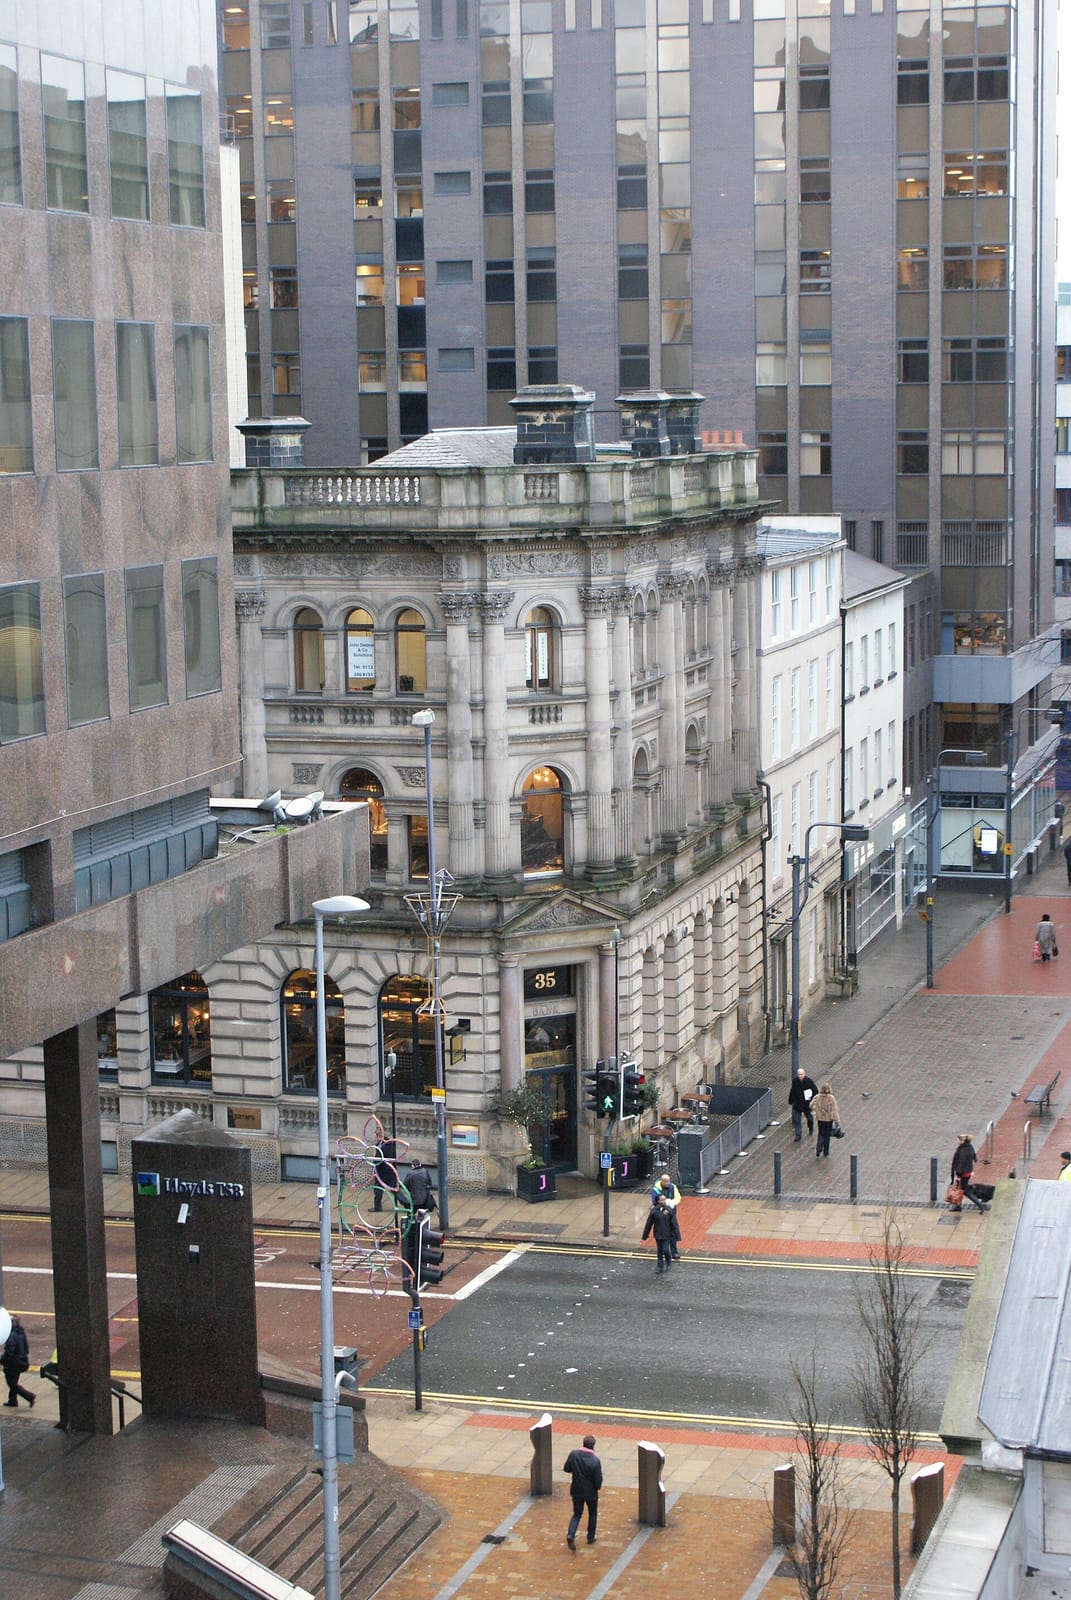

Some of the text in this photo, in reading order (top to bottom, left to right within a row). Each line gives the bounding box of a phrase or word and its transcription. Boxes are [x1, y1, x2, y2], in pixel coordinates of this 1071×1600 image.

[535, 971, 556, 989] 35
[532, 1005, 559, 1016] BANK
[621, 1161, 628, 1177] J
[163, 1177, 245, 1198] Lloyds TSB
[539, 1174, 547, 1190] J
